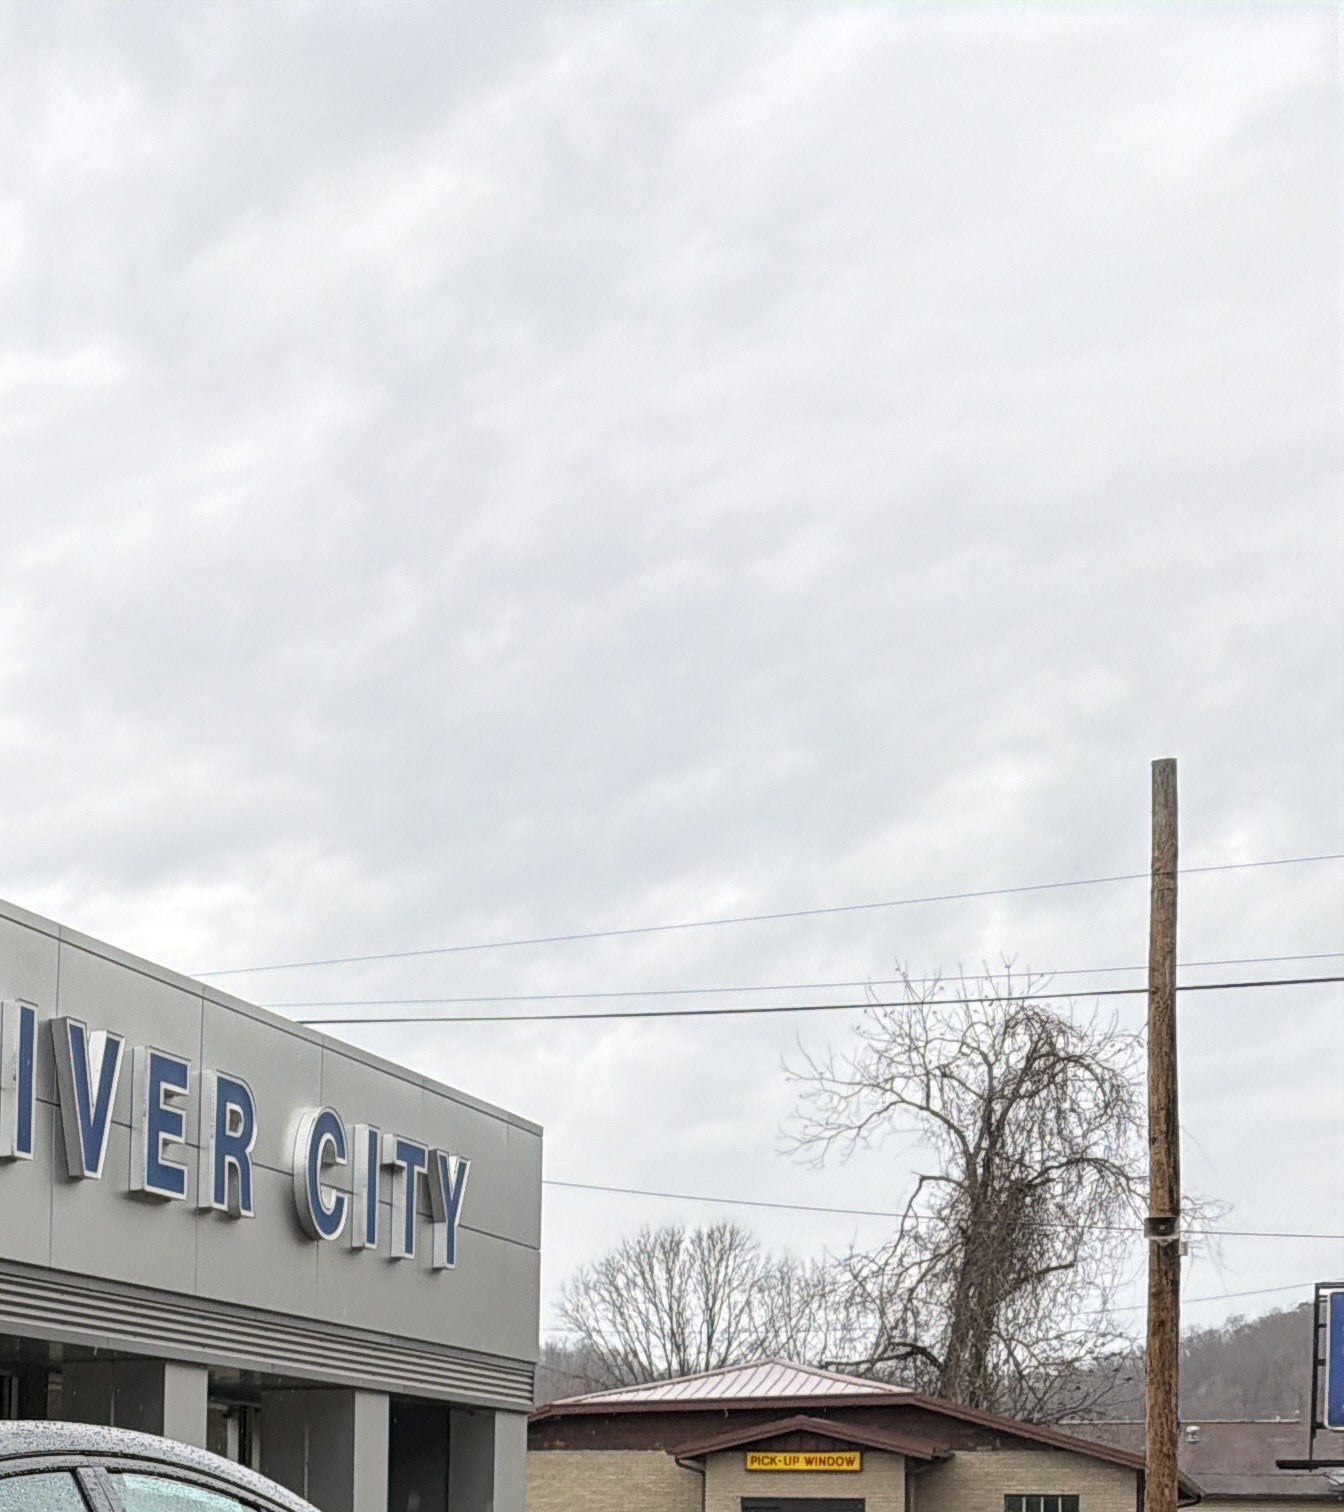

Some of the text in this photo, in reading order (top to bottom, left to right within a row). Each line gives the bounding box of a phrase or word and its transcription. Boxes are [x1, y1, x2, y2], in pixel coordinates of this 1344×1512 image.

[293, 1106, 471, 1271] CITY
[750, 1455, 857, 1467] PICK-UP WINDOW
